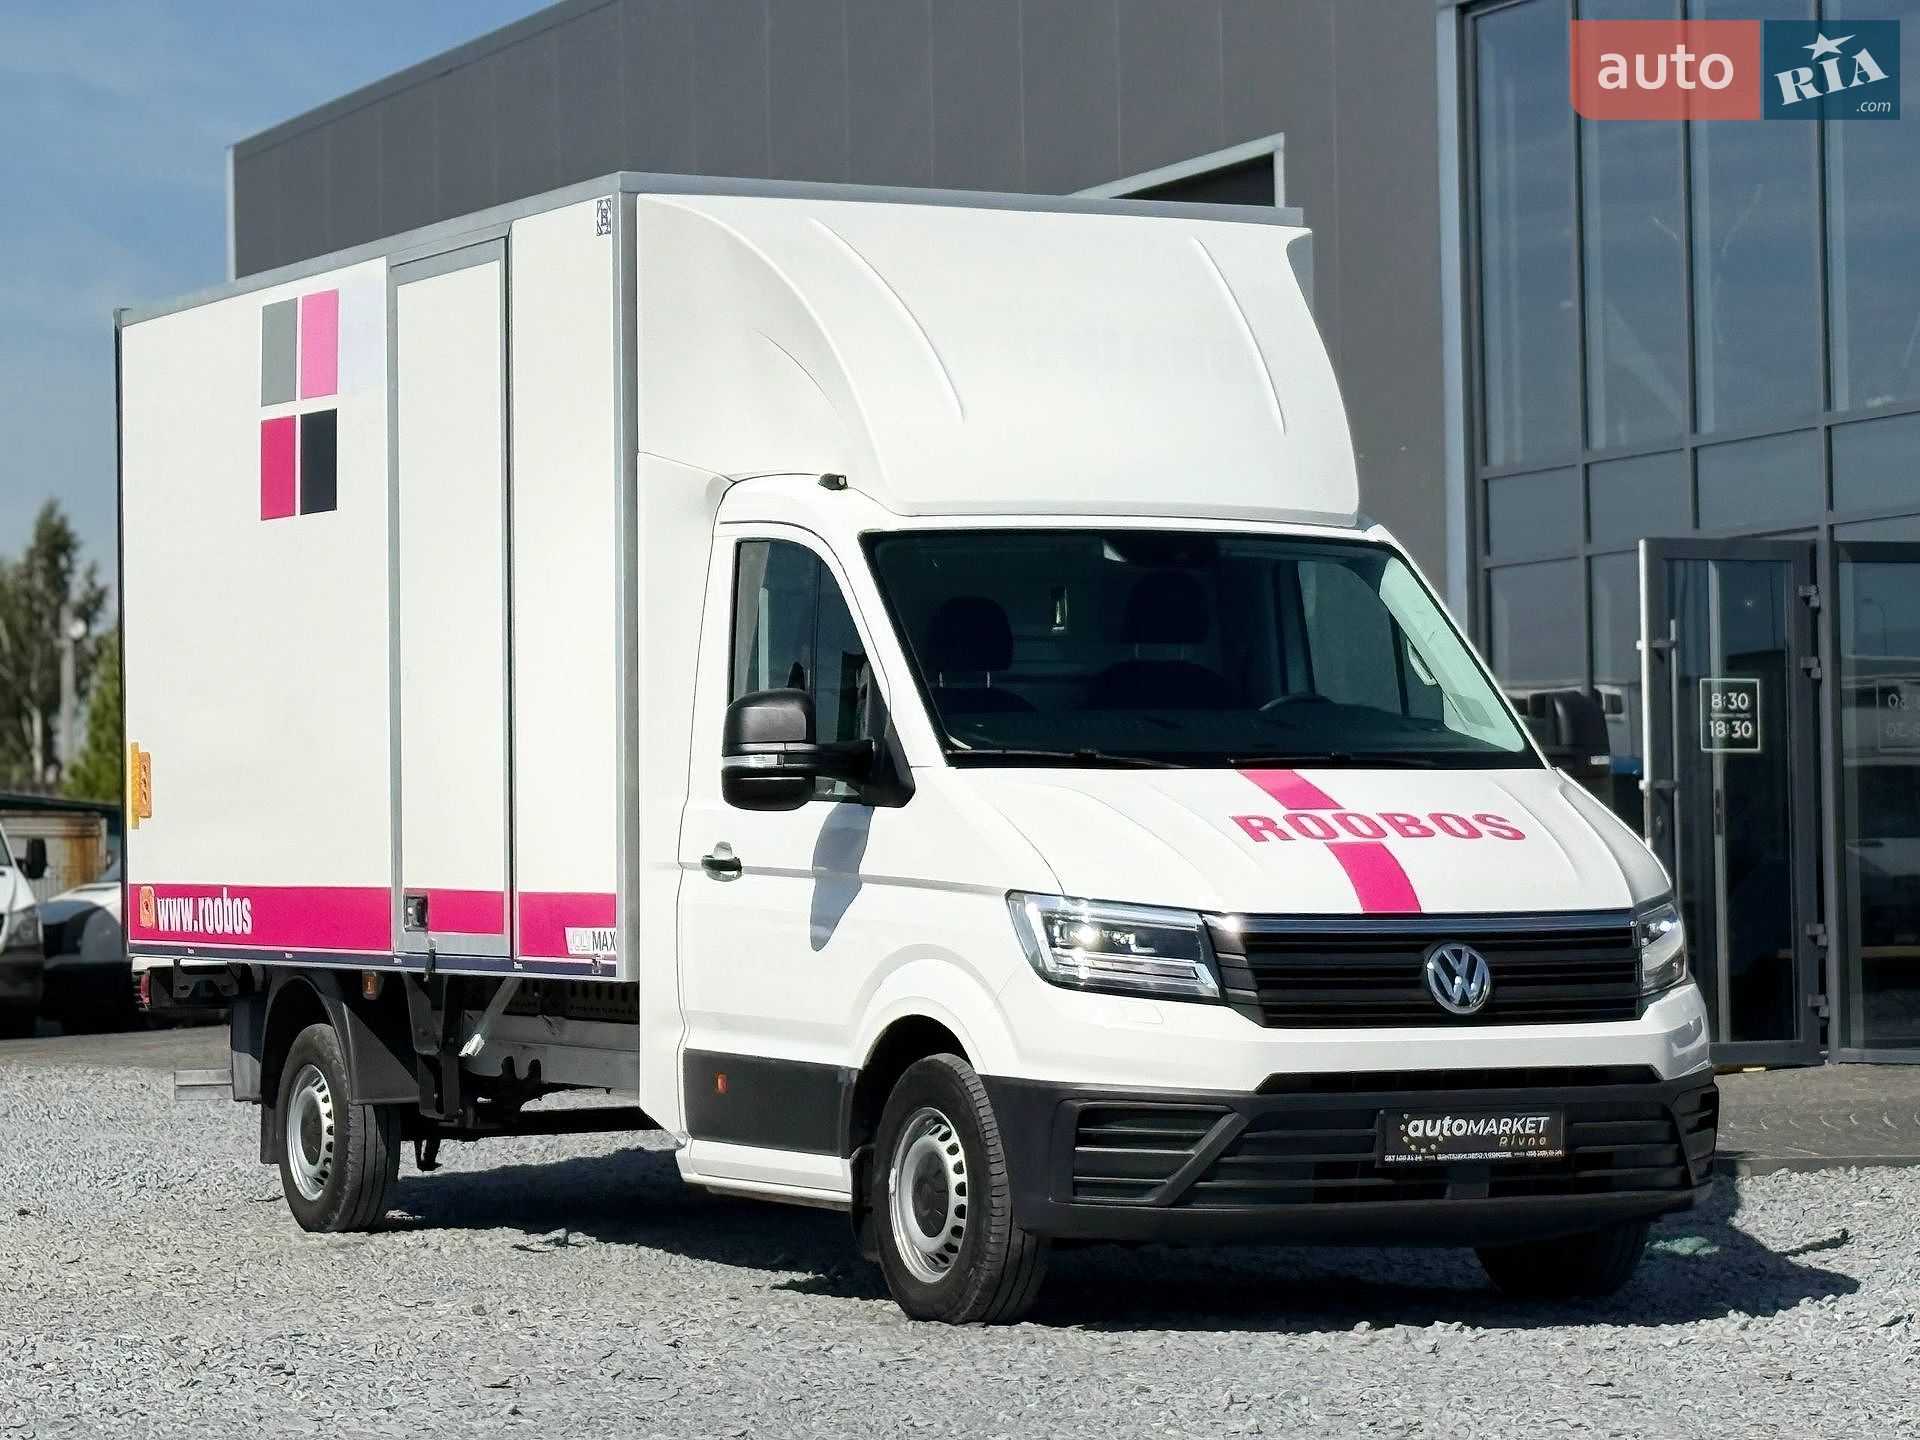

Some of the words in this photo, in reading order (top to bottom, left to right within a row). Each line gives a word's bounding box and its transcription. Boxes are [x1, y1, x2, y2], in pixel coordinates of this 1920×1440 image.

[1711, 692, 1749, 710] 8:30
[1710, 720, 1752, 738] 18:30
[1229, 812, 1526, 841] ROOBOS
[156, 886, 252, 935] www.roobos
